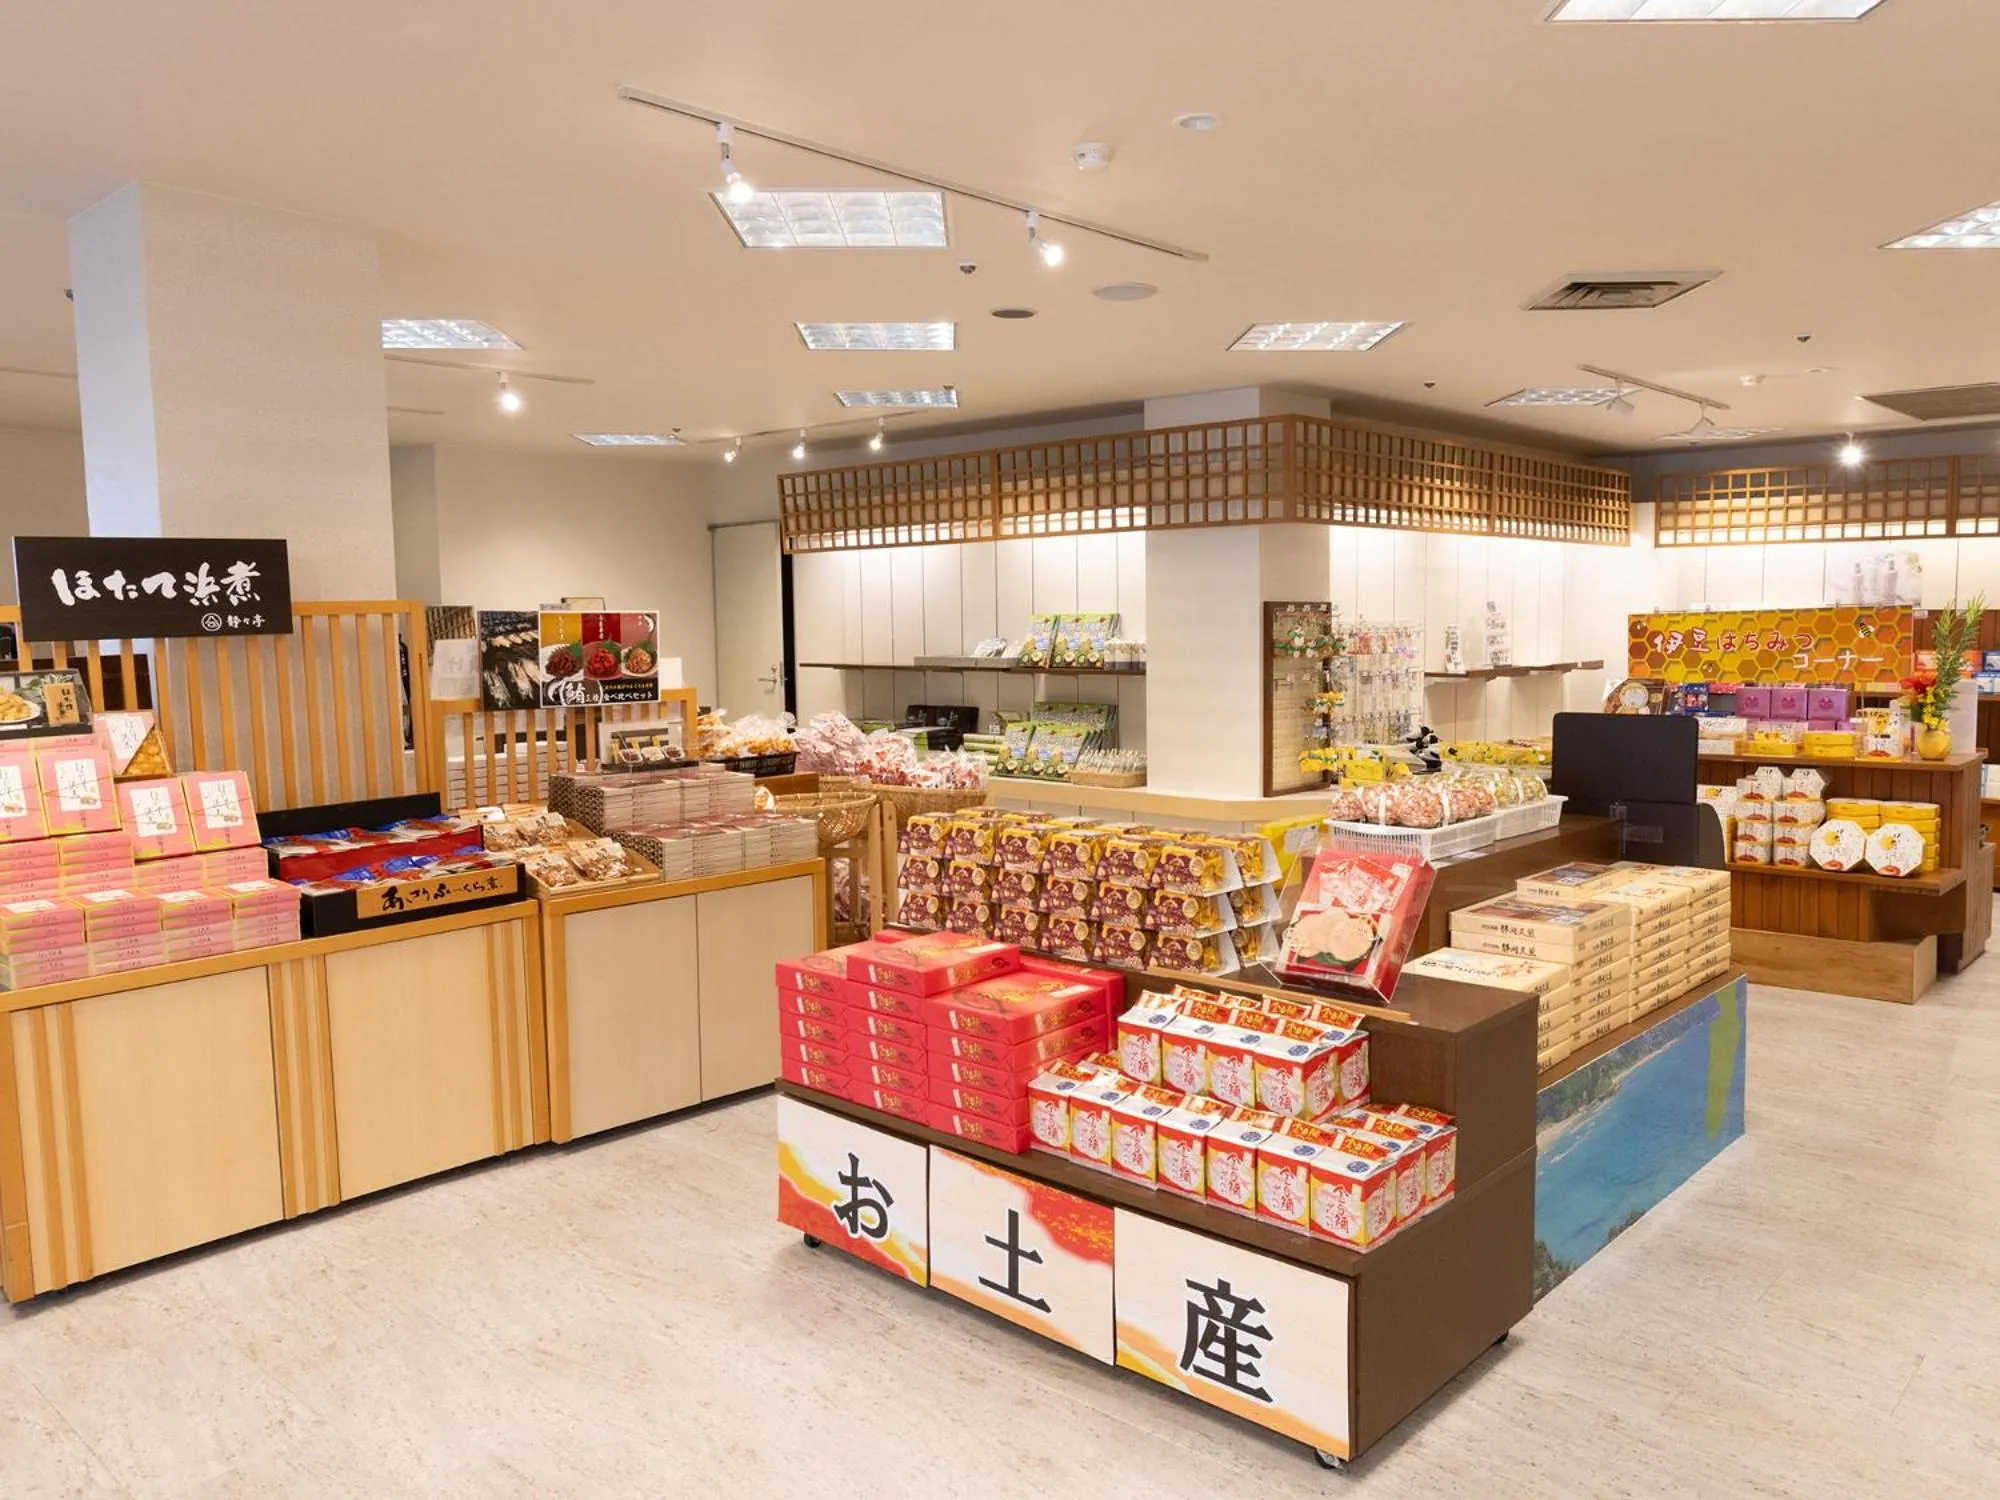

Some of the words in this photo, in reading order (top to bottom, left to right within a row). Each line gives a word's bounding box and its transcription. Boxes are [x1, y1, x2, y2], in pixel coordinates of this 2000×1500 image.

[51, 561, 261, 607] ほたて浜煮
[1654, 628, 1814, 653] 伊豆はちみつ
[1792, 650, 1886, 671] コーナー
